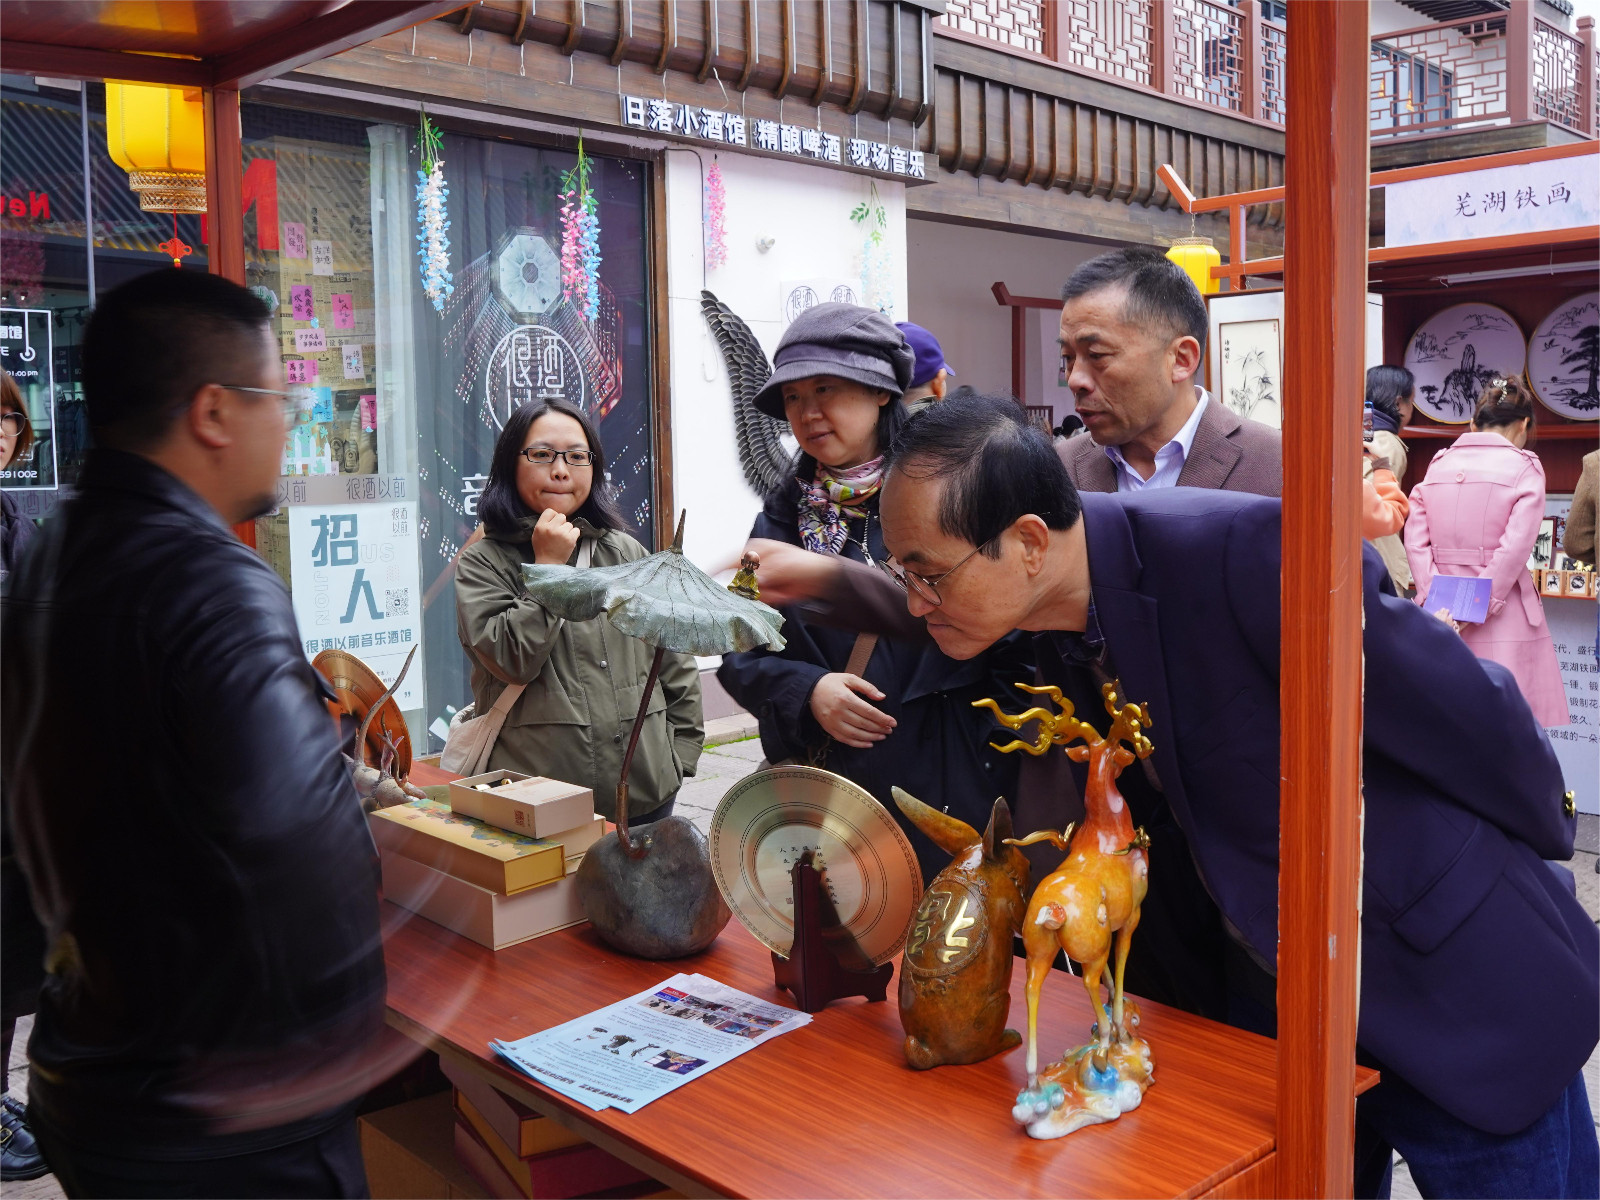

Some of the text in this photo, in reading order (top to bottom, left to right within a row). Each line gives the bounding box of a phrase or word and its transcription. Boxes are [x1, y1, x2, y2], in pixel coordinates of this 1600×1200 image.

[623, 95, 926, 178] 日落小酒馆 精酿啤酒 现场音乐
[1454, 181, 1571, 218] 芜湖铁画
[346, 476, 406, 500] 很酒以前
[360, 542, 395, 564] US
[305, 628, 412, 654] 很酒以前音乐酒馆
